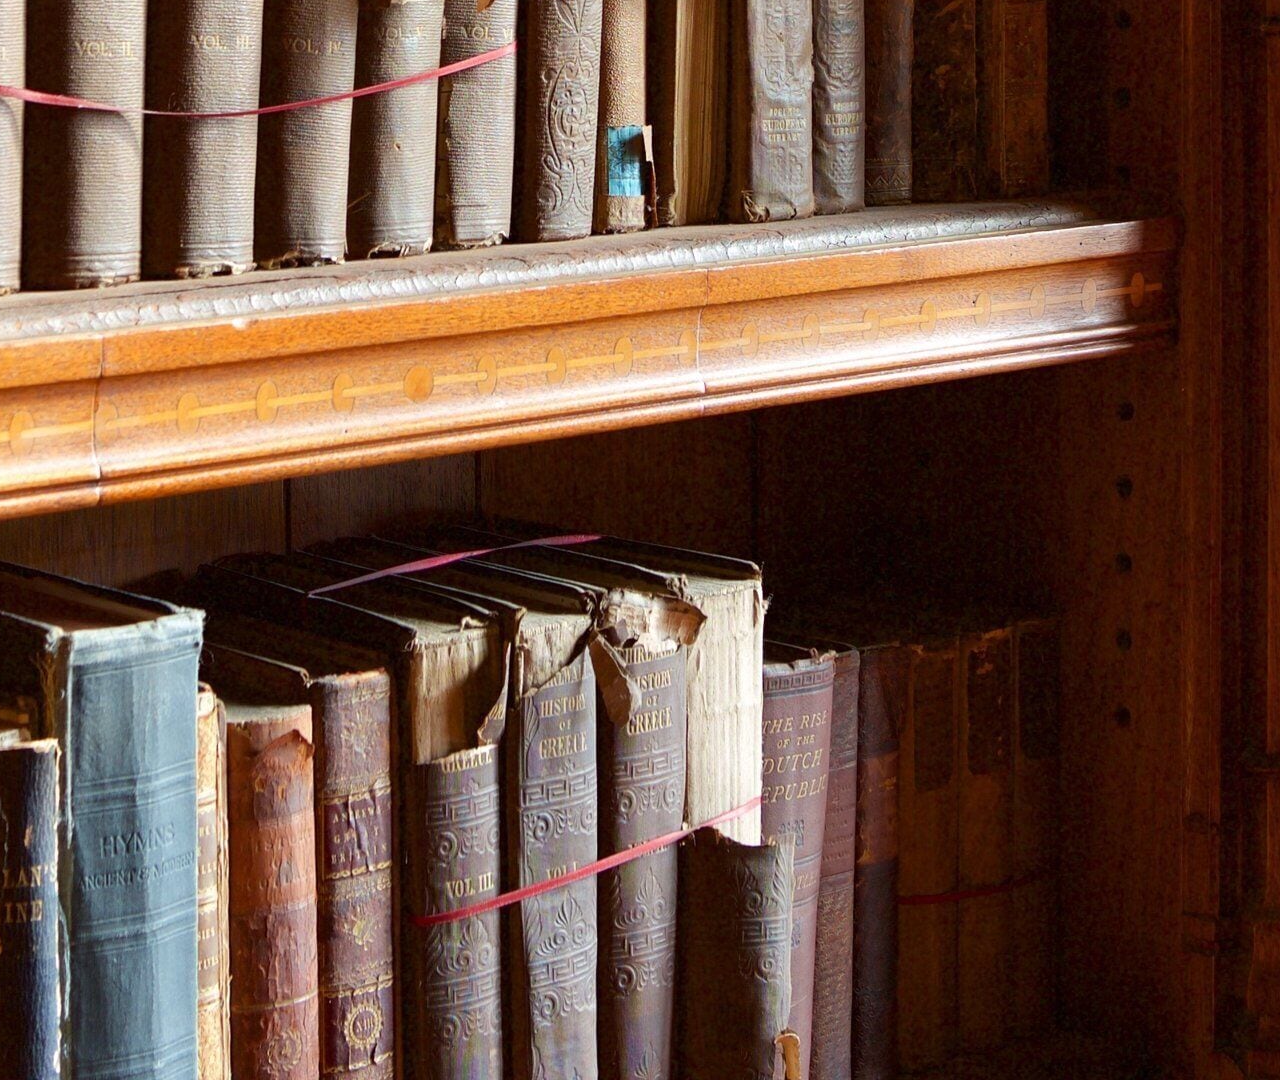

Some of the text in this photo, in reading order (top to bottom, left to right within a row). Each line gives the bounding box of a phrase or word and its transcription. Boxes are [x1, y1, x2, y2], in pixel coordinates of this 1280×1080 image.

[539, 692, 587, 719] HISTORY
[559, 718, 572, 731] OF
[627, 706, 673, 737] GREECE
[762, 709, 828, 735] THE RISE
[538, 729, 589, 761] GREECE
[776, 734, 816, 750] OF THE
[762, 748, 823, 776] DUTCH
[100, 822, 176, 860] HYMNS
[80, 866, 137, 892] ANCIENT
[446, 877, 476, 898] VOL.
